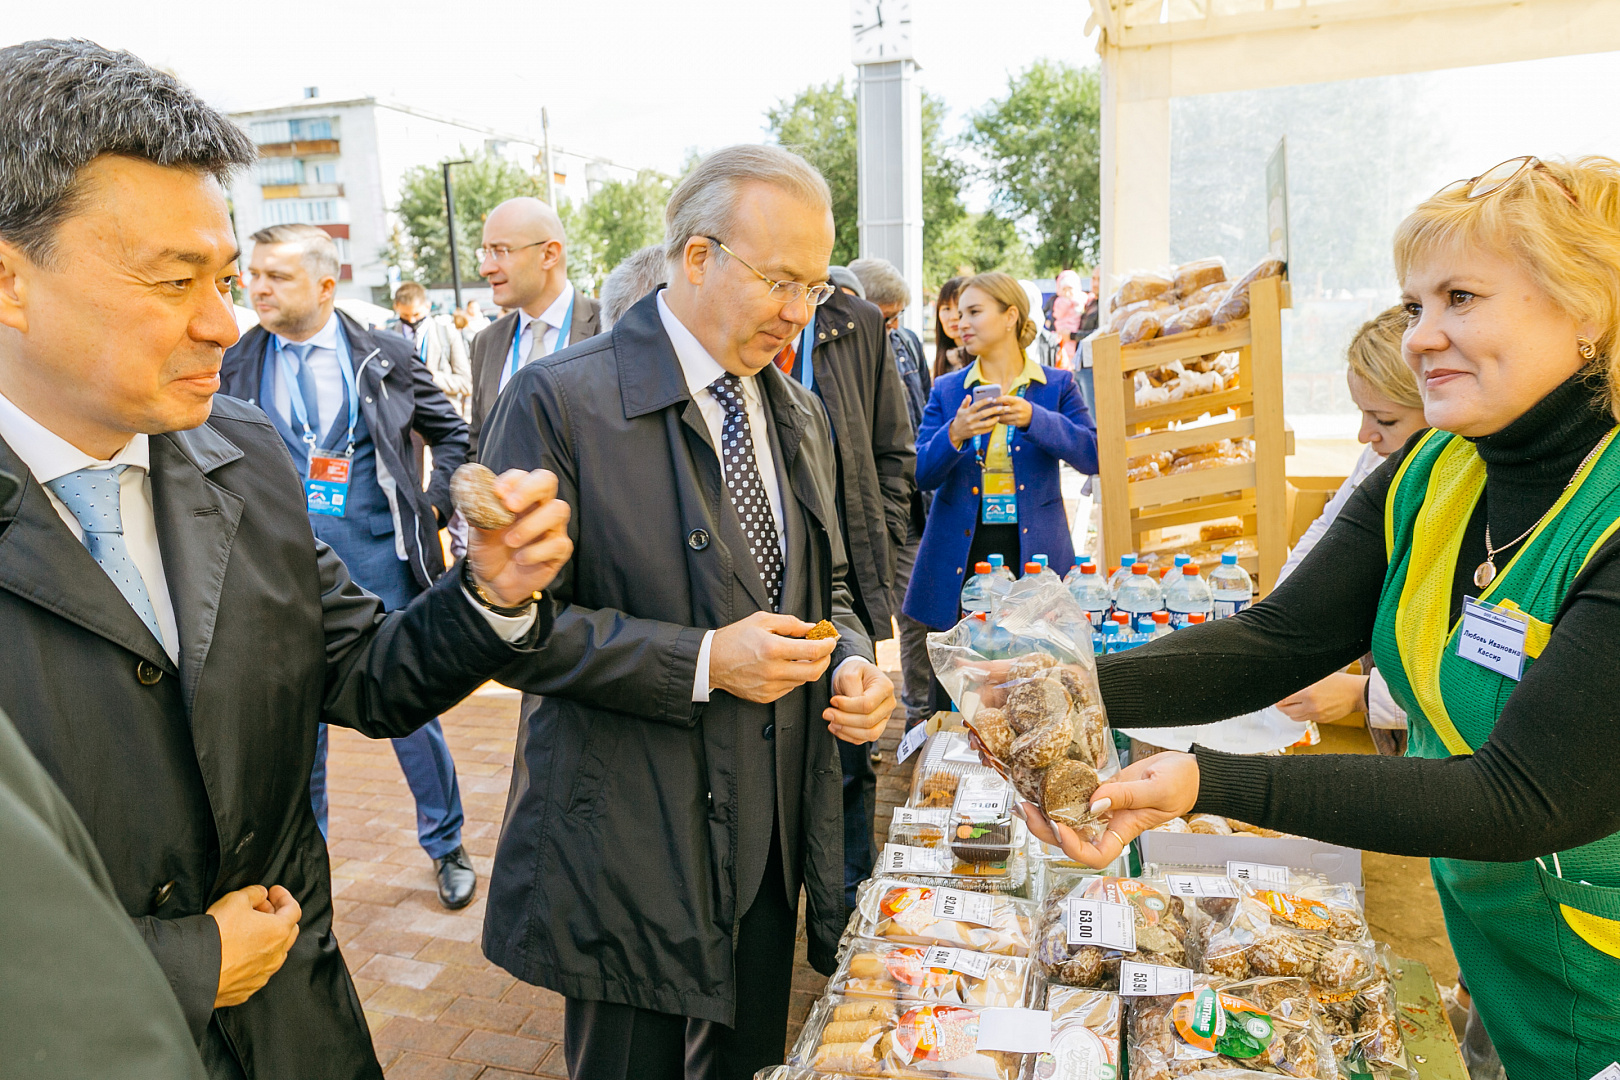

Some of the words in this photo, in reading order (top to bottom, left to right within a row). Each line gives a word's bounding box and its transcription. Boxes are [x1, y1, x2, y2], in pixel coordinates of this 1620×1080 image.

[1463, 629, 1487, 644] Любовь
[1488, 638, 1521, 657] Ивановна
[1477, 647, 1502, 662] Кассир
[1078, 909, 1092, 938] 63,00
[1132, 972, 1147, 993] 53,90
[1200, 996, 1214, 1032] МЯТНЫЕ
